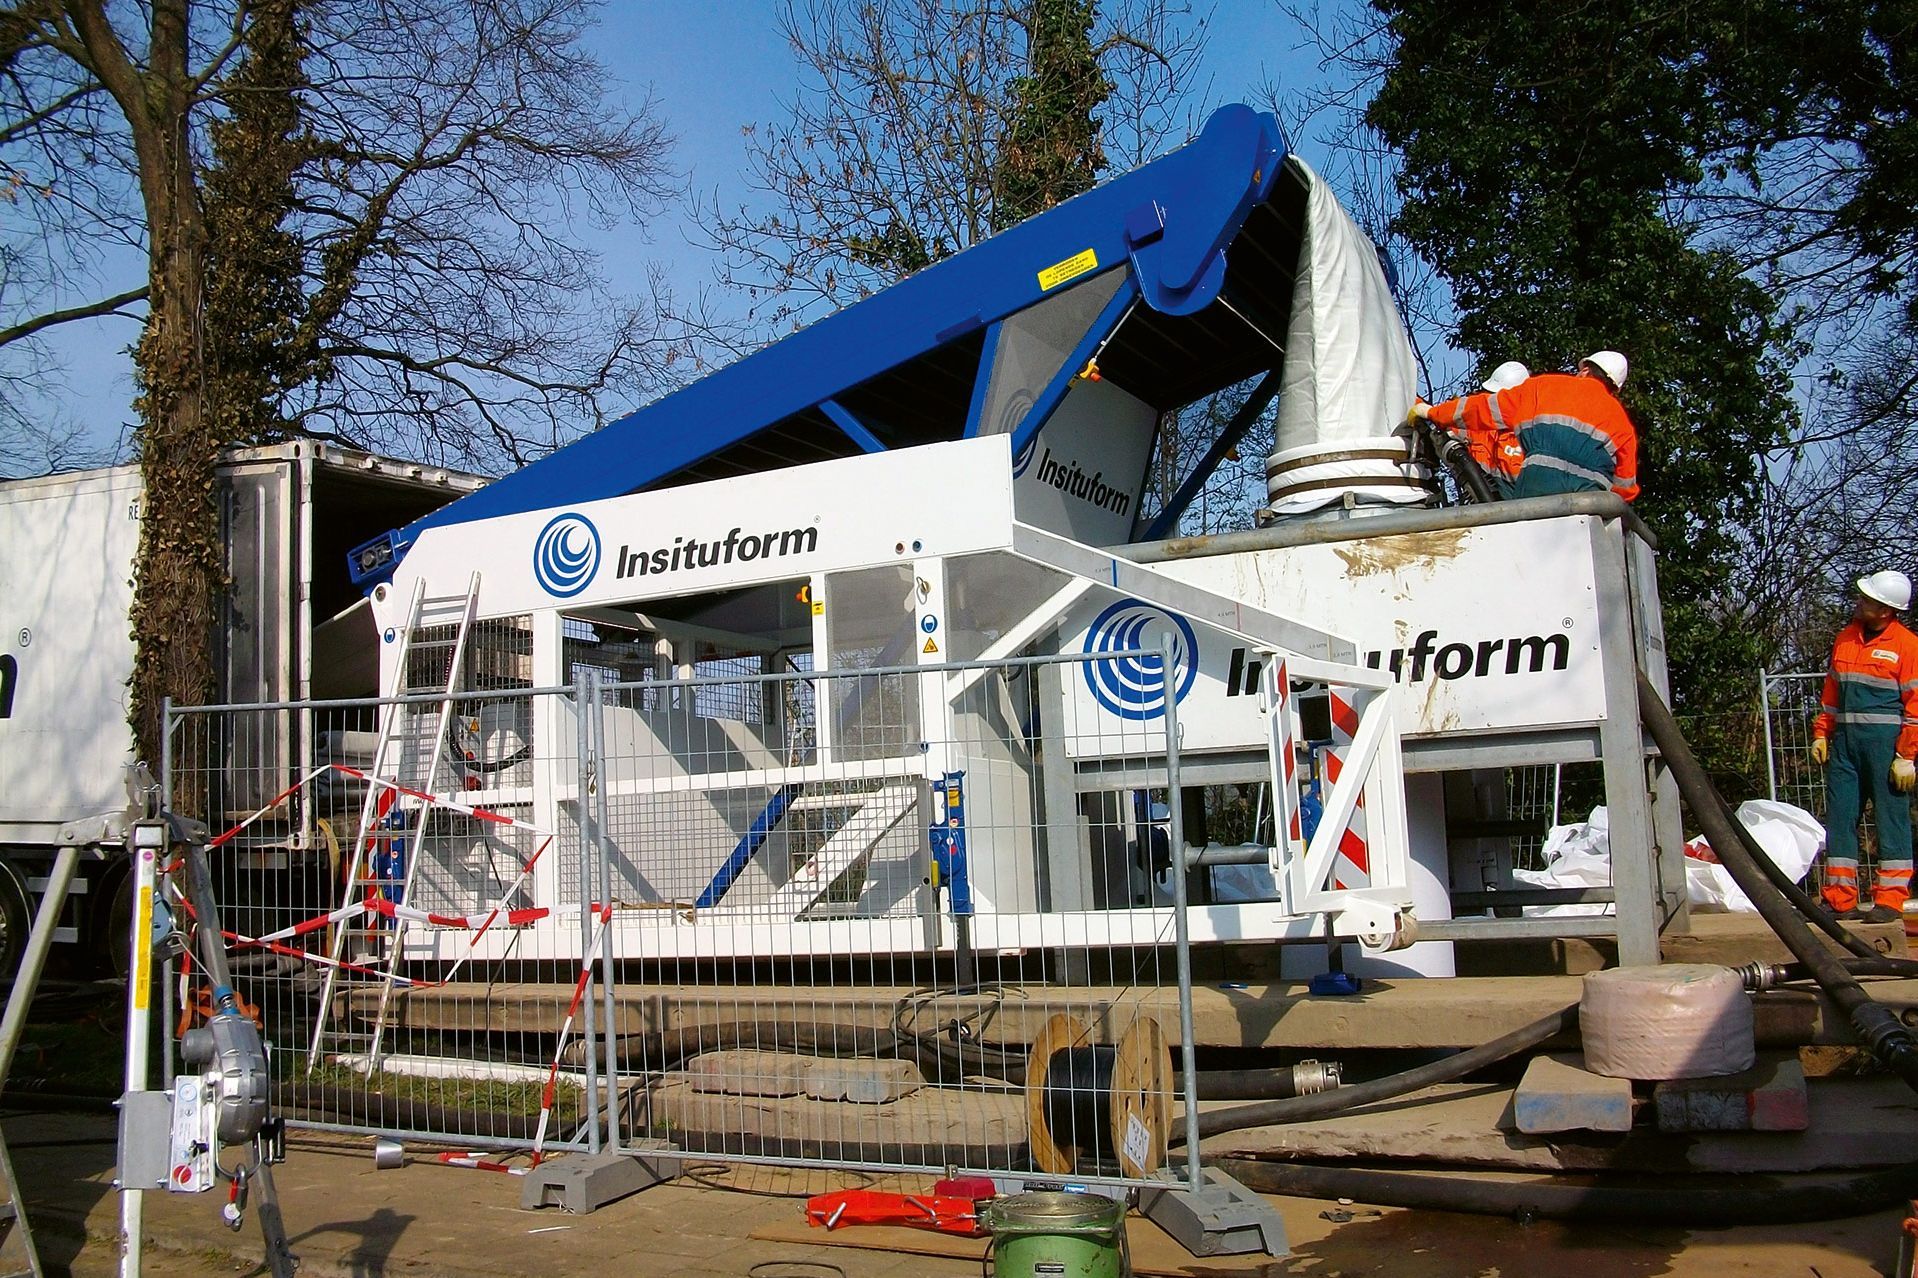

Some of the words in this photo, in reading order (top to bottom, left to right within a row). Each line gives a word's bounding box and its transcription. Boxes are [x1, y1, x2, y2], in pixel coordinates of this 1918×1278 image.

[1036, 447, 1130, 516] Insituform
[616, 527, 818, 579] Insituform
[1226, 630, 1570, 696] Iuform
